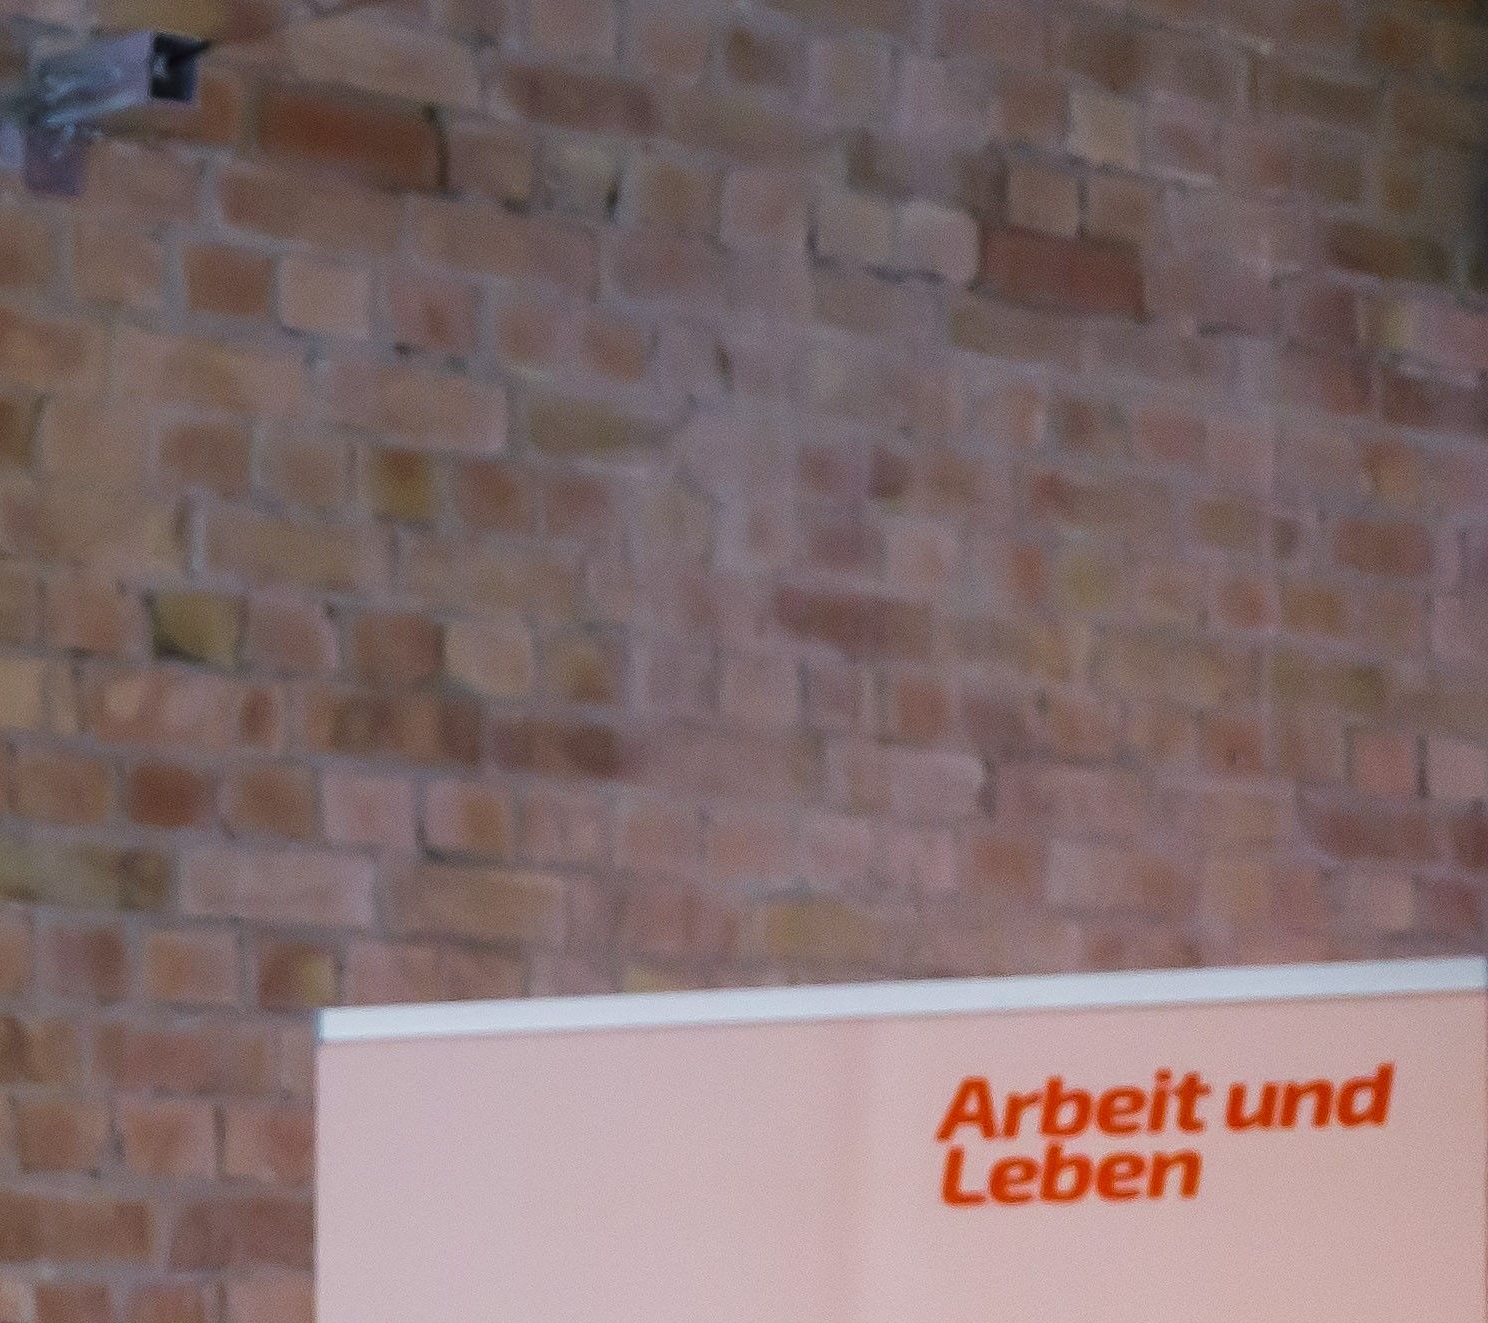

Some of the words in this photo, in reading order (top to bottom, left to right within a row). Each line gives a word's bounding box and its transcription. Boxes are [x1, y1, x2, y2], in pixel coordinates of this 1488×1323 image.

[936, 1067, 1211, 1142] Arbeit
[1224, 1062, 1395, 1132] und
[940, 1143, 1202, 1207] Leben
